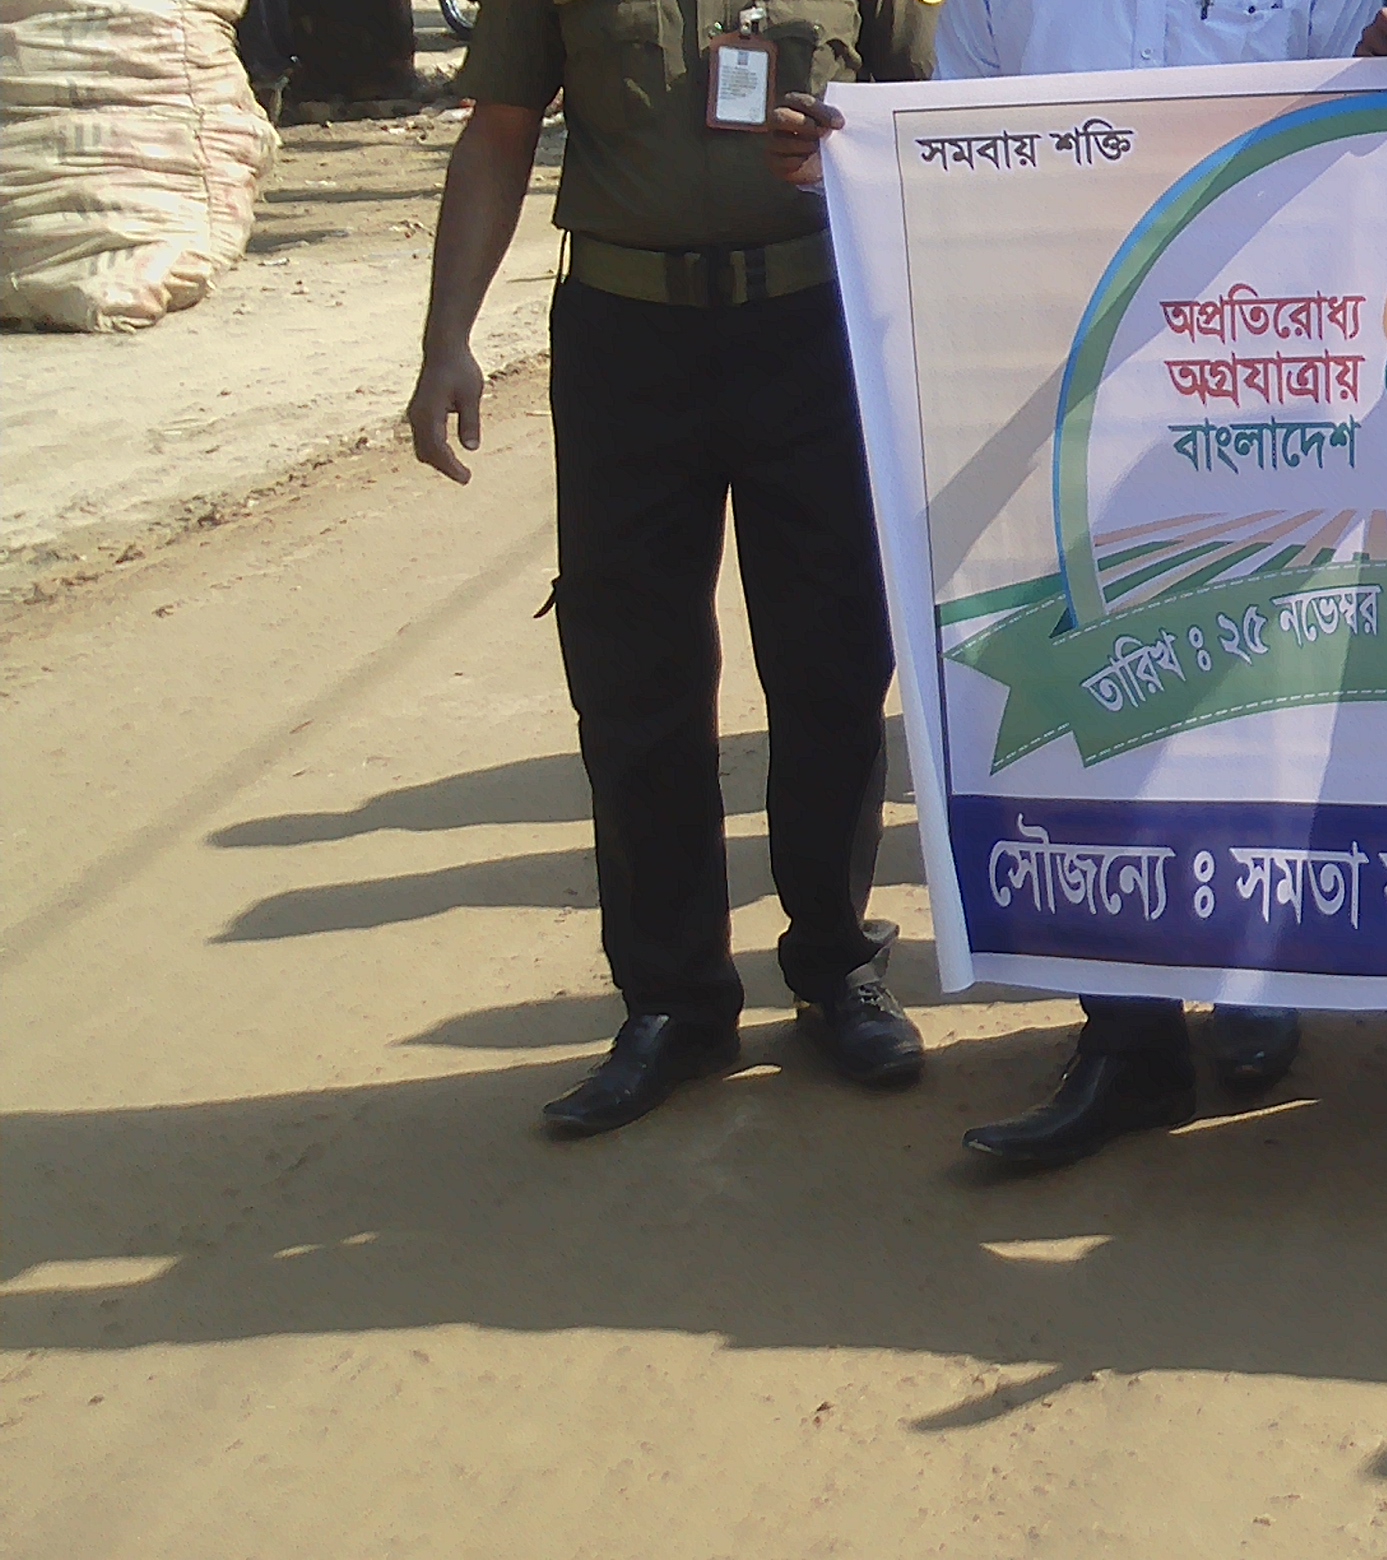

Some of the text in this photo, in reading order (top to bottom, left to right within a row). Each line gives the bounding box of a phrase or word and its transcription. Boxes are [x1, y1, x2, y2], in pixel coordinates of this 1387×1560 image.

[917, 119, 1133, 172] সমবায় শক্তি
[1161, 284, 1364, 342] অপ্রতিরোধ্য
[1164, 349, 1364, 405] অগ্রযাত্রায়
[1169, 418, 1358, 472] বাংলাদেশ
[1082, 635, 1182, 716] তারিখ
[1220, 603, 1268, 660] ২৫
[1275, 581, 1380, 652] নভেম্বর
[989, 813, 1175, 922] সৌজন্যে
[1230, 840, 1367, 930] সমতা
